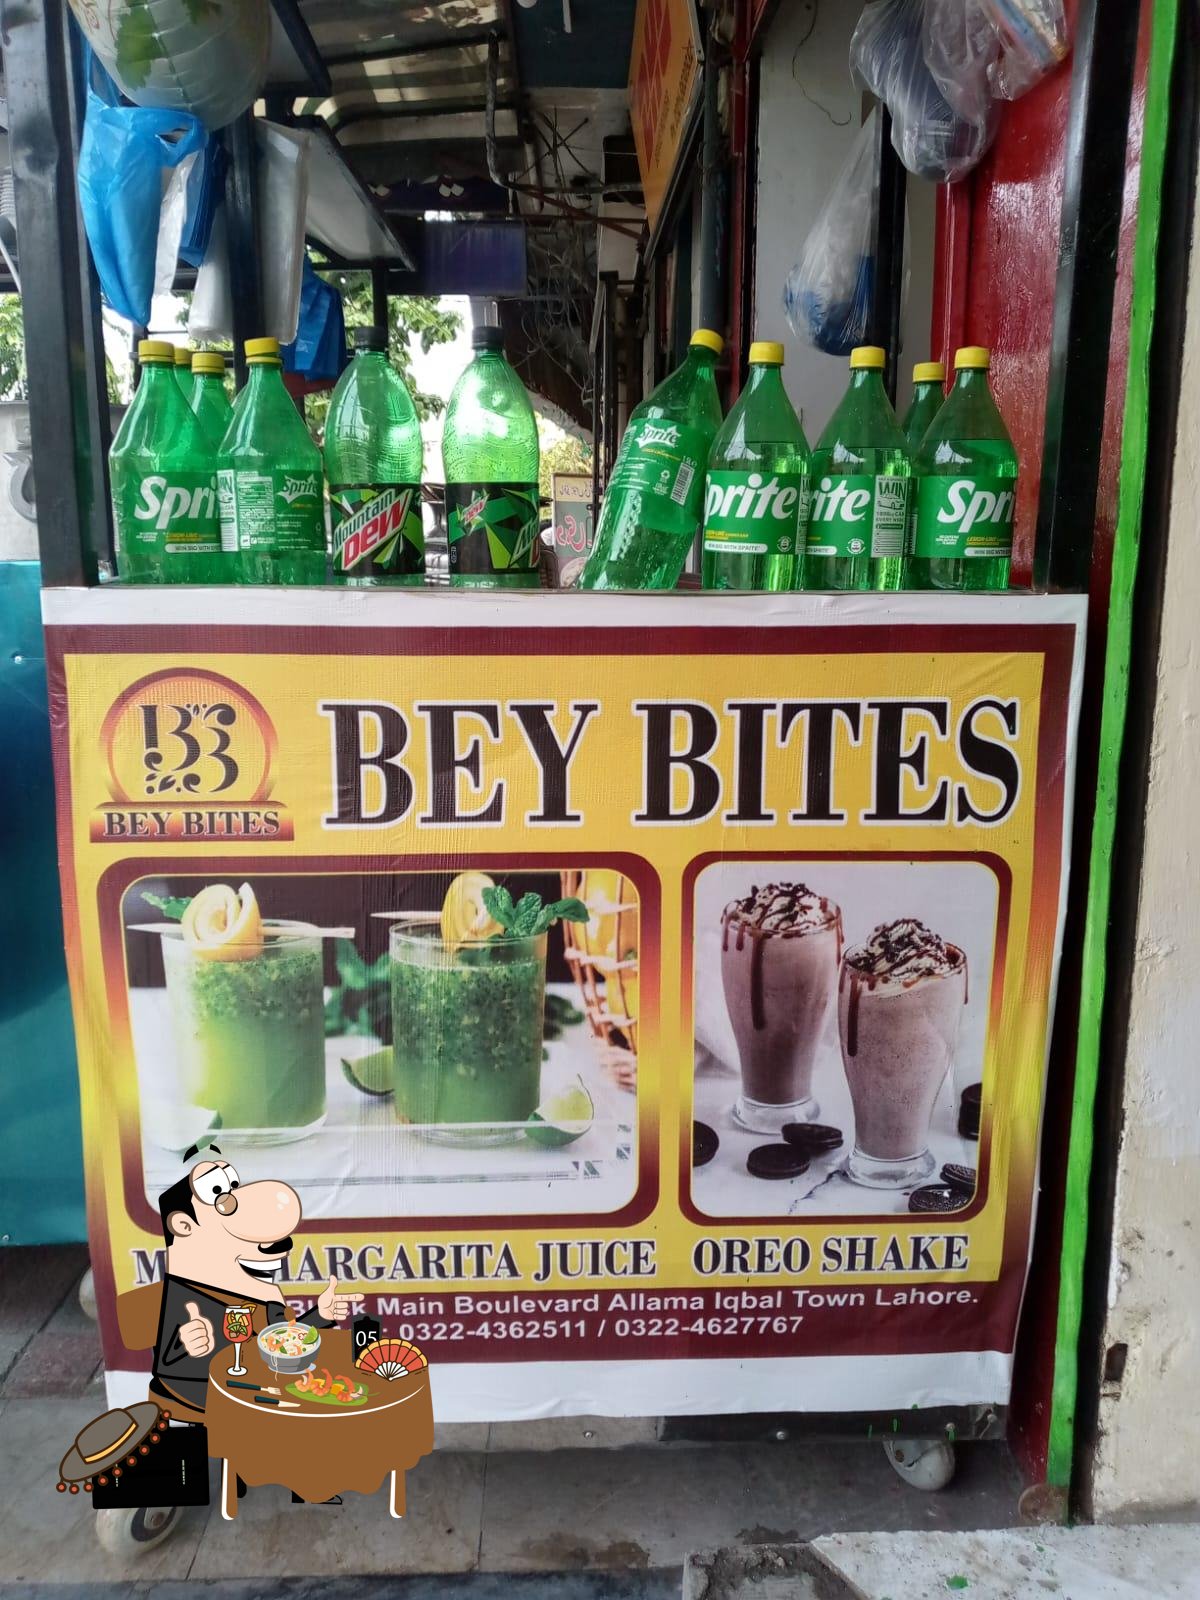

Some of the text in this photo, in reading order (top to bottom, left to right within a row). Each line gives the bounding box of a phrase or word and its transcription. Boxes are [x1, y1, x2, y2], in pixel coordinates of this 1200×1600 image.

[134, 475, 220, 530] Spri
[704, 473, 798, 526] prite
[317, 695, 1021, 831] BEY BITES
[103, 810, 280, 837] BEY BITES
[533, 1239, 657, 1283] JUICE
[692, 1235, 969, 1275] OREO SHAKE
[286, 1288, 979, 1318] Blk Main Boulevard Allama Iqbal Town Lahore.
[399, 1319, 586, 1341] 0322-4362511
[597, 1319, 606, 1338] /
[615, 1316, 804, 1337] 0322-4627767
